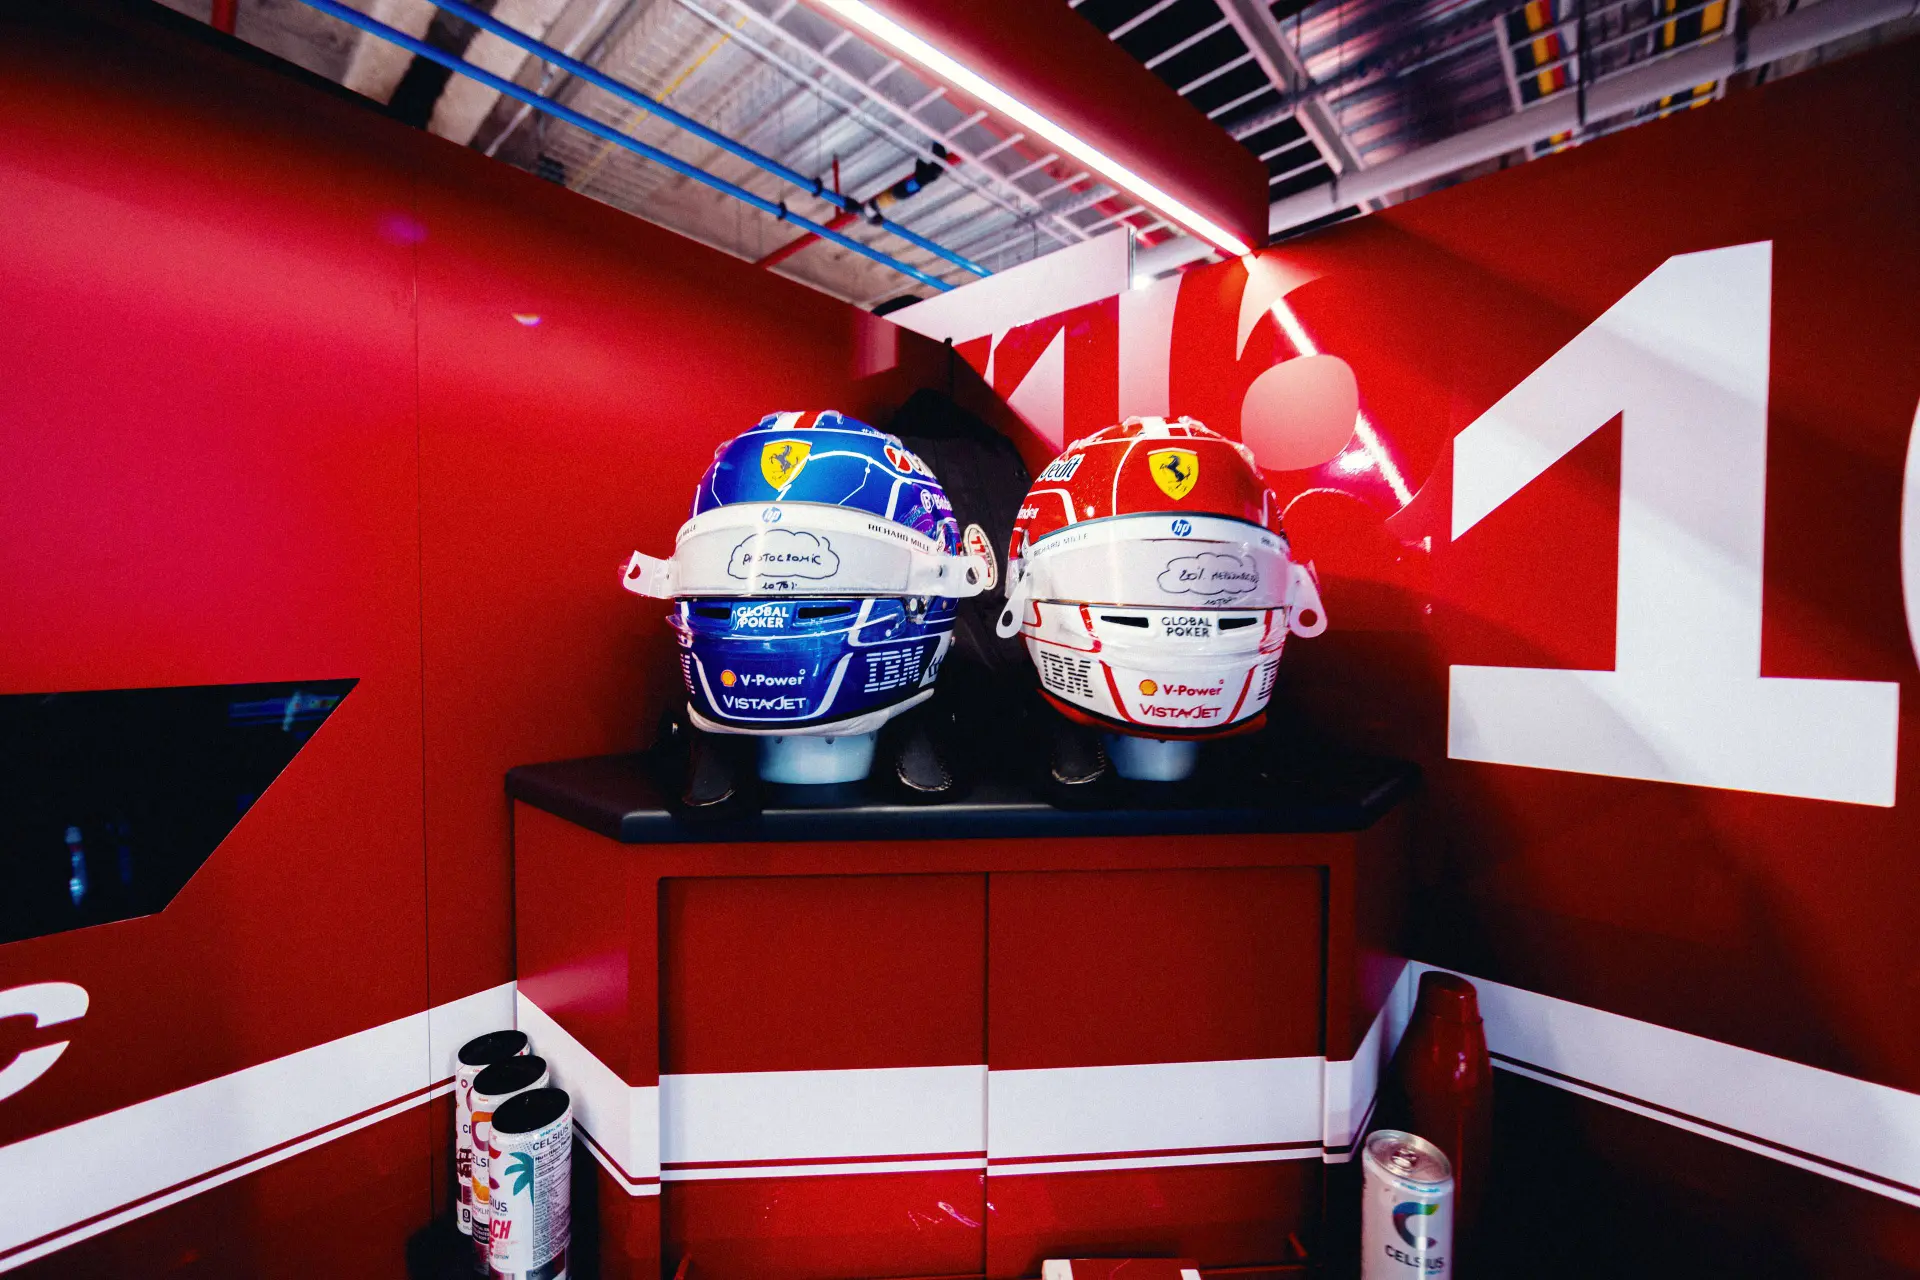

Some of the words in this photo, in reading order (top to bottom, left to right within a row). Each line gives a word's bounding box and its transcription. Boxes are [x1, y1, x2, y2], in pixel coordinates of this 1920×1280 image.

[868, 523, 909, 543] RICHARD
[1172, 519, 1192, 537] hp
[737, 606, 790, 618] GLOBAL
[740, 616, 784, 629] POKER
[1161, 616, 1212, 627] GLOBAL
[1166, 627, 1210, 638] POKER
[864, 645, 924, 693] IBM
[1040, 651, 1094, 698] IBM
[740, 674, 805, 687] V-Power
[1163, 684, 1223, 696] V-Power
[532, 1122, 570, 1151] CELSIUS
[1385, 1244, 1445, 1270] CELSIUS
